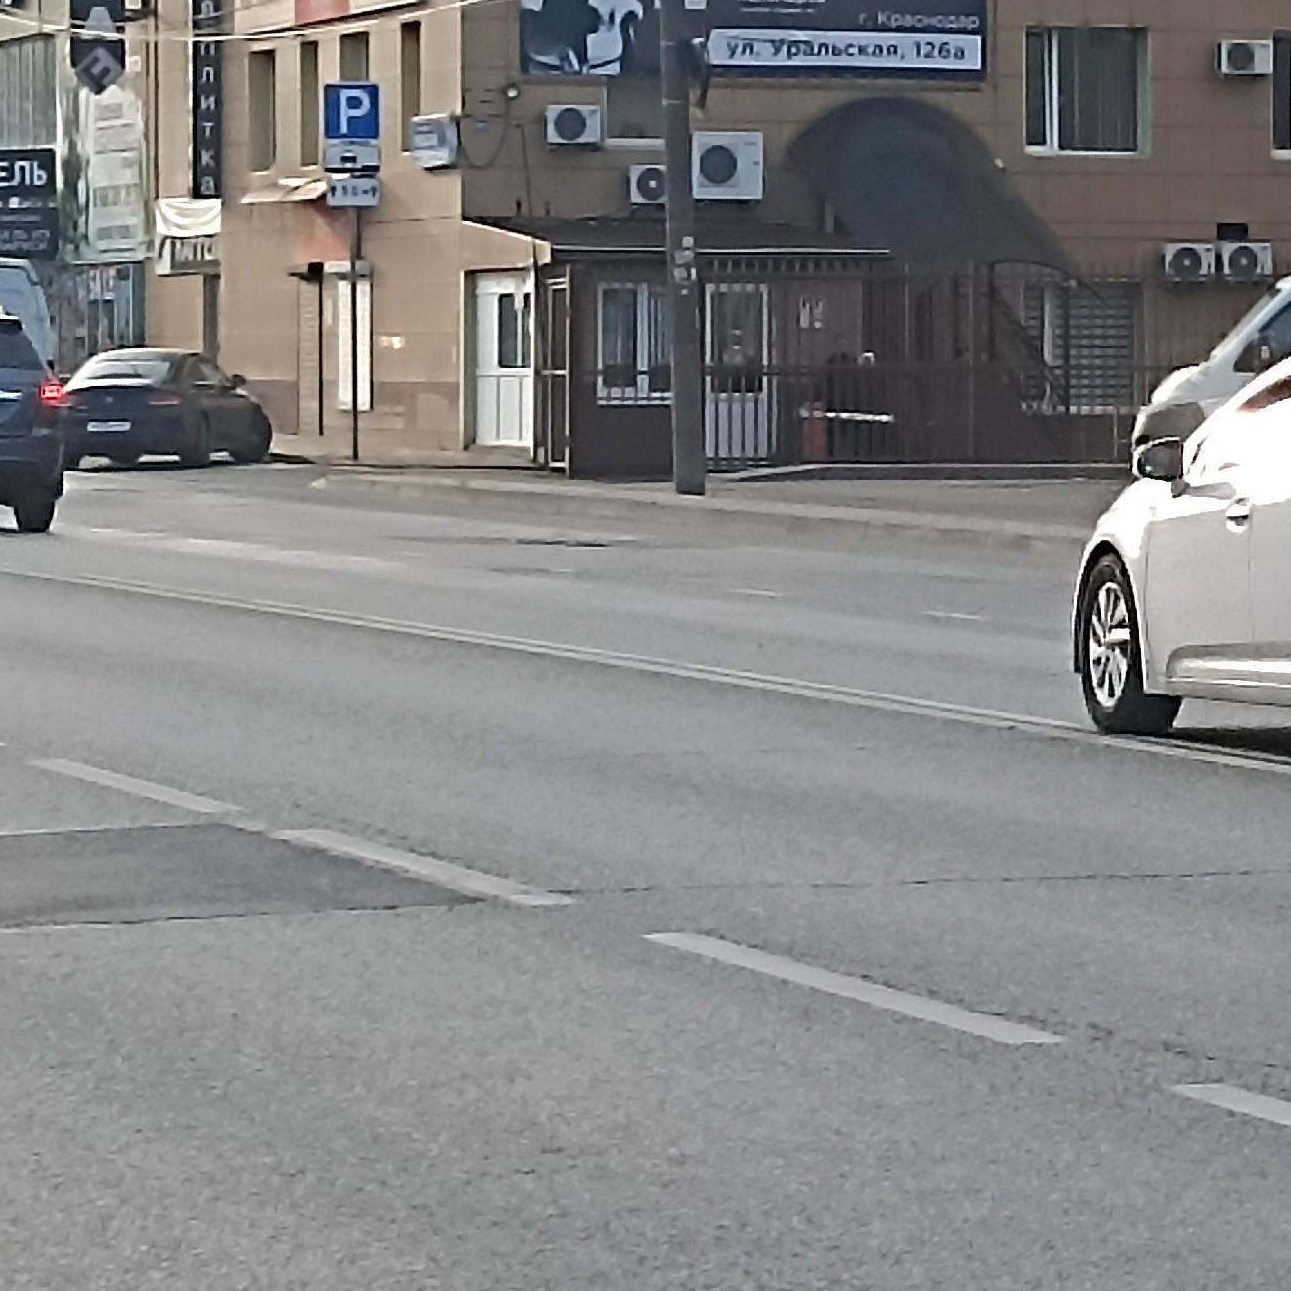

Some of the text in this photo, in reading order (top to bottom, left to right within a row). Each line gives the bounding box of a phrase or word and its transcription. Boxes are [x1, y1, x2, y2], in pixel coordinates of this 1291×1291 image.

[726, 38, 966, 62] ул. Уральская, 126а
[338, 88, 371, 134] P
